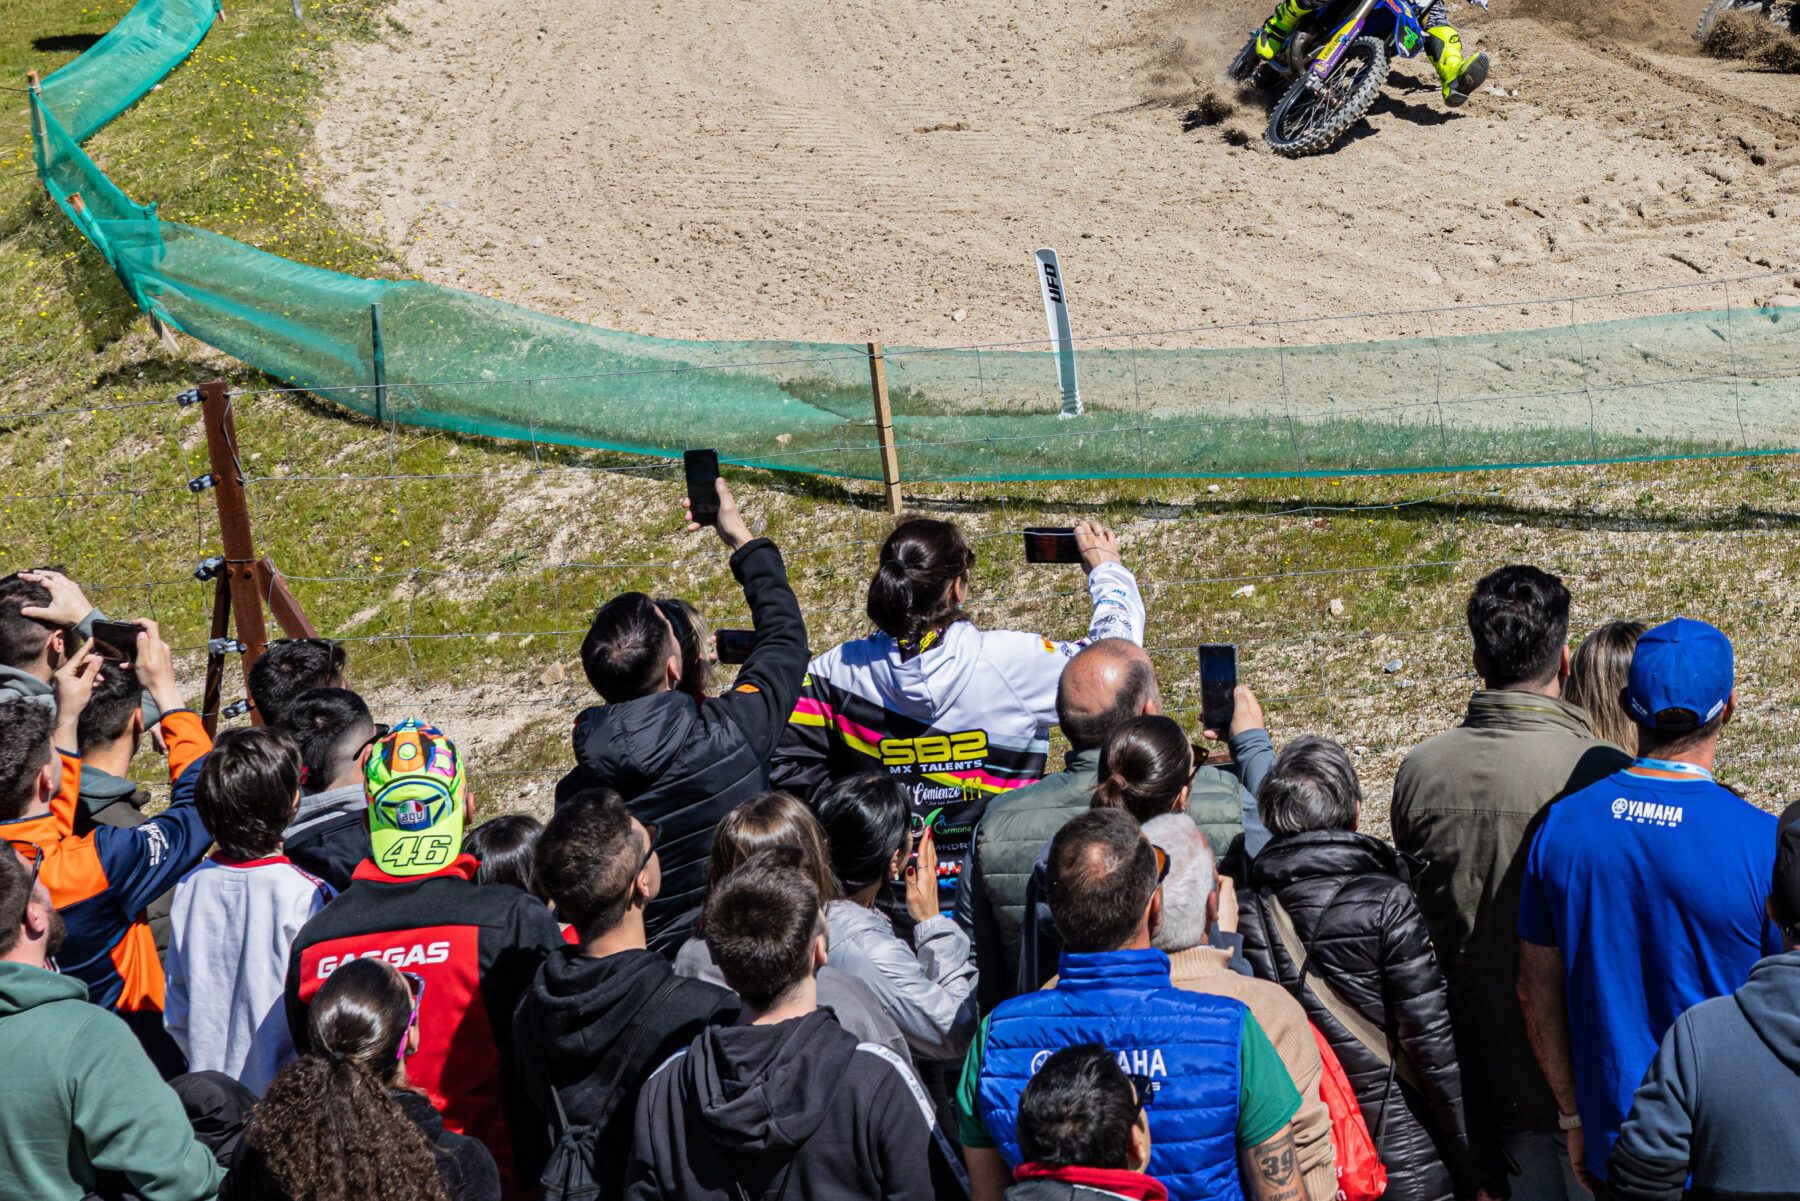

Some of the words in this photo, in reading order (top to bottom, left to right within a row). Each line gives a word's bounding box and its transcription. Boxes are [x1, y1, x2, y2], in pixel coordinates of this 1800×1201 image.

[1043, 262, 1063, 304] UFO
[881, 731, 988, 766] SB2
[889, 762, 913, 775] MX
[919, 760, 983, 773] TALENTS
[1612, 813, 1679, 828] RACING
[1628, 797, 1684, 823] YAMAHA
[382, 835, 452, 867] 46
[1261, 1145, 1294, 1180] 39
